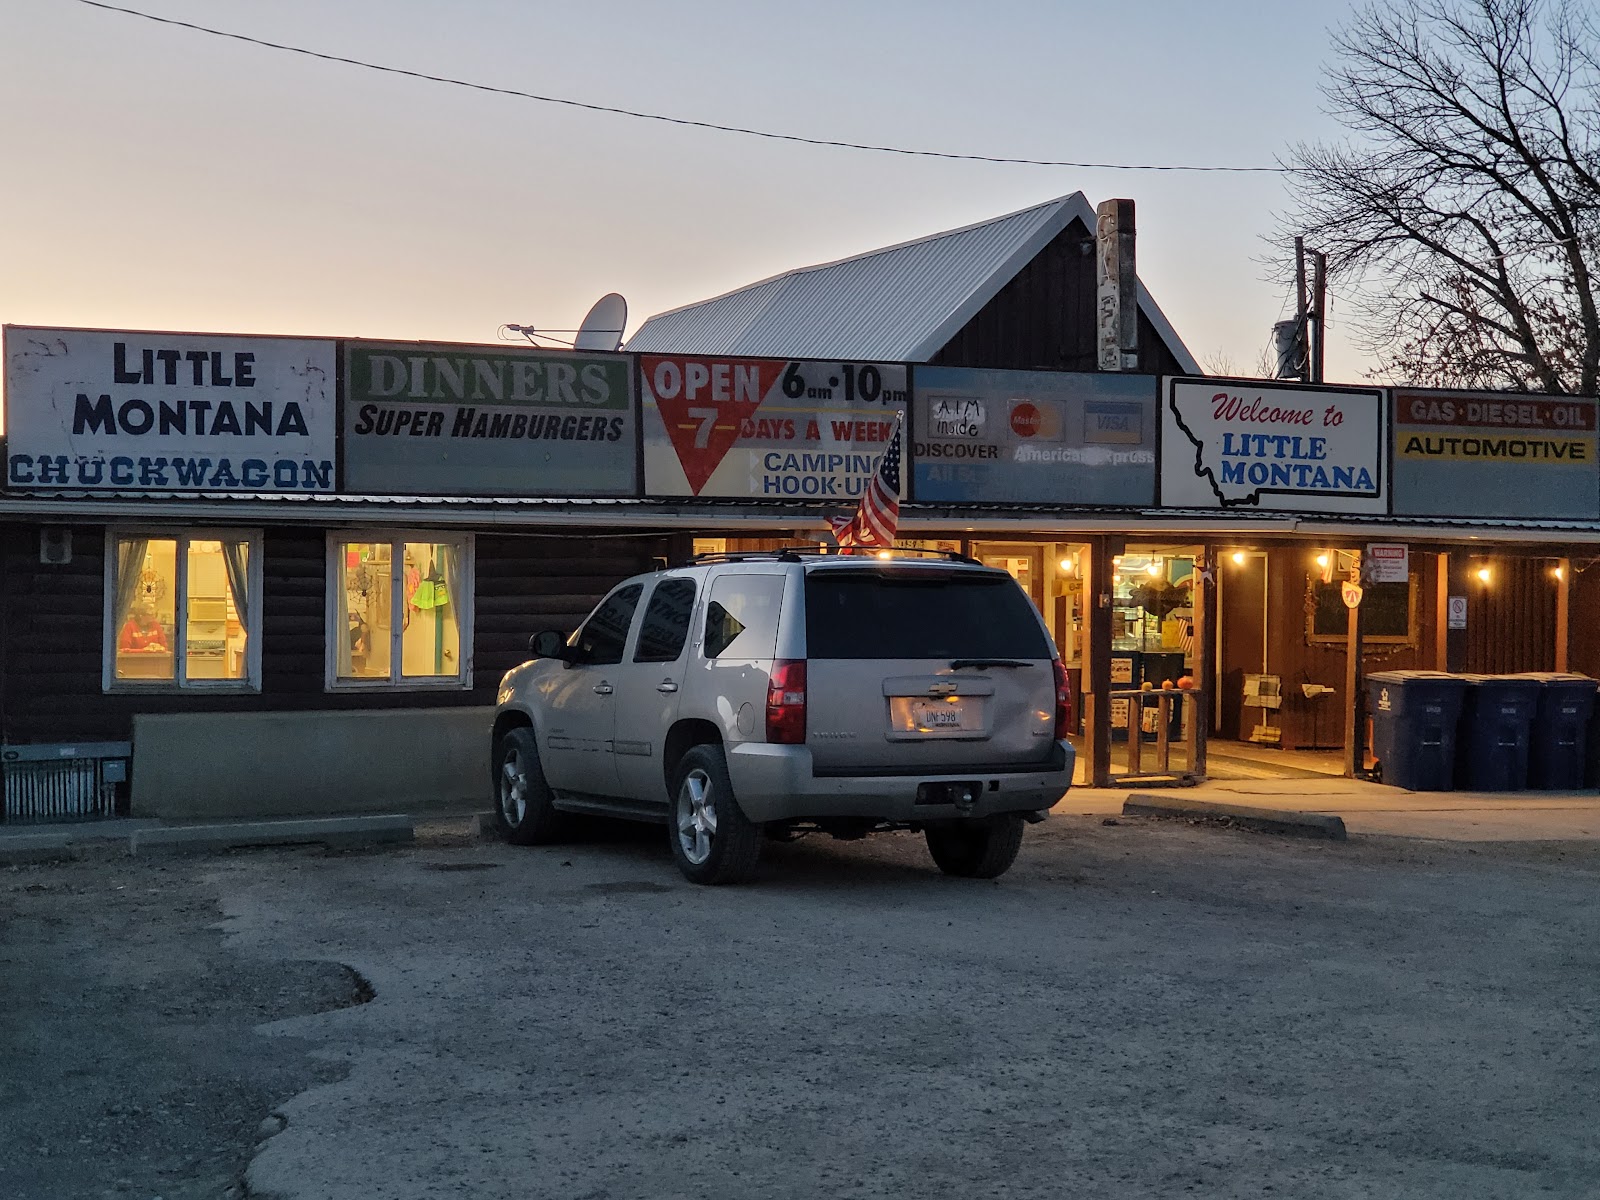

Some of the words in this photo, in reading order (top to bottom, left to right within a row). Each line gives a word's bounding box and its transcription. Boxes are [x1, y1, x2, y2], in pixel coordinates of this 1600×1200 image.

[113, 342, 256, 387] LITTLE
[367, 355, 610, 404] DINNERS
[653, 361, 760, 403] OPEN
[72, 393, 310, 436] MONTANA
[355, 404, 445, 436] SUPER
[451, 407, 624, 442] HAMBURGERS
[1097, 414, 1128, 430] VISA
[1212, 392, 1313, 426] Welcome
[1323, 405, 1344, 427] to
[1410, 400, 1456, 421] GAS
[1467, 403, 1544, 425] DIESEL
[1552, 407, 1586, 426] OIL
[688, 407, 719, 449] 7
[740, 418, 795, 440] DAYS
[805, 419, 821, 441] A
[831, 420, 892, 442] WEEK
[937, 416, 979, 437] inside
[914, 442, 998, 459] DISCOVER
[1222, 432, 1327, 460] LITTLE
[1404, 436, 1586, 459] AUTOMOTIVE
[9, 454, 334, 489] CHUCKWAGON
[1221, 460, 1376, 490] MONTANA
[940, 710, 956, 722] 598
